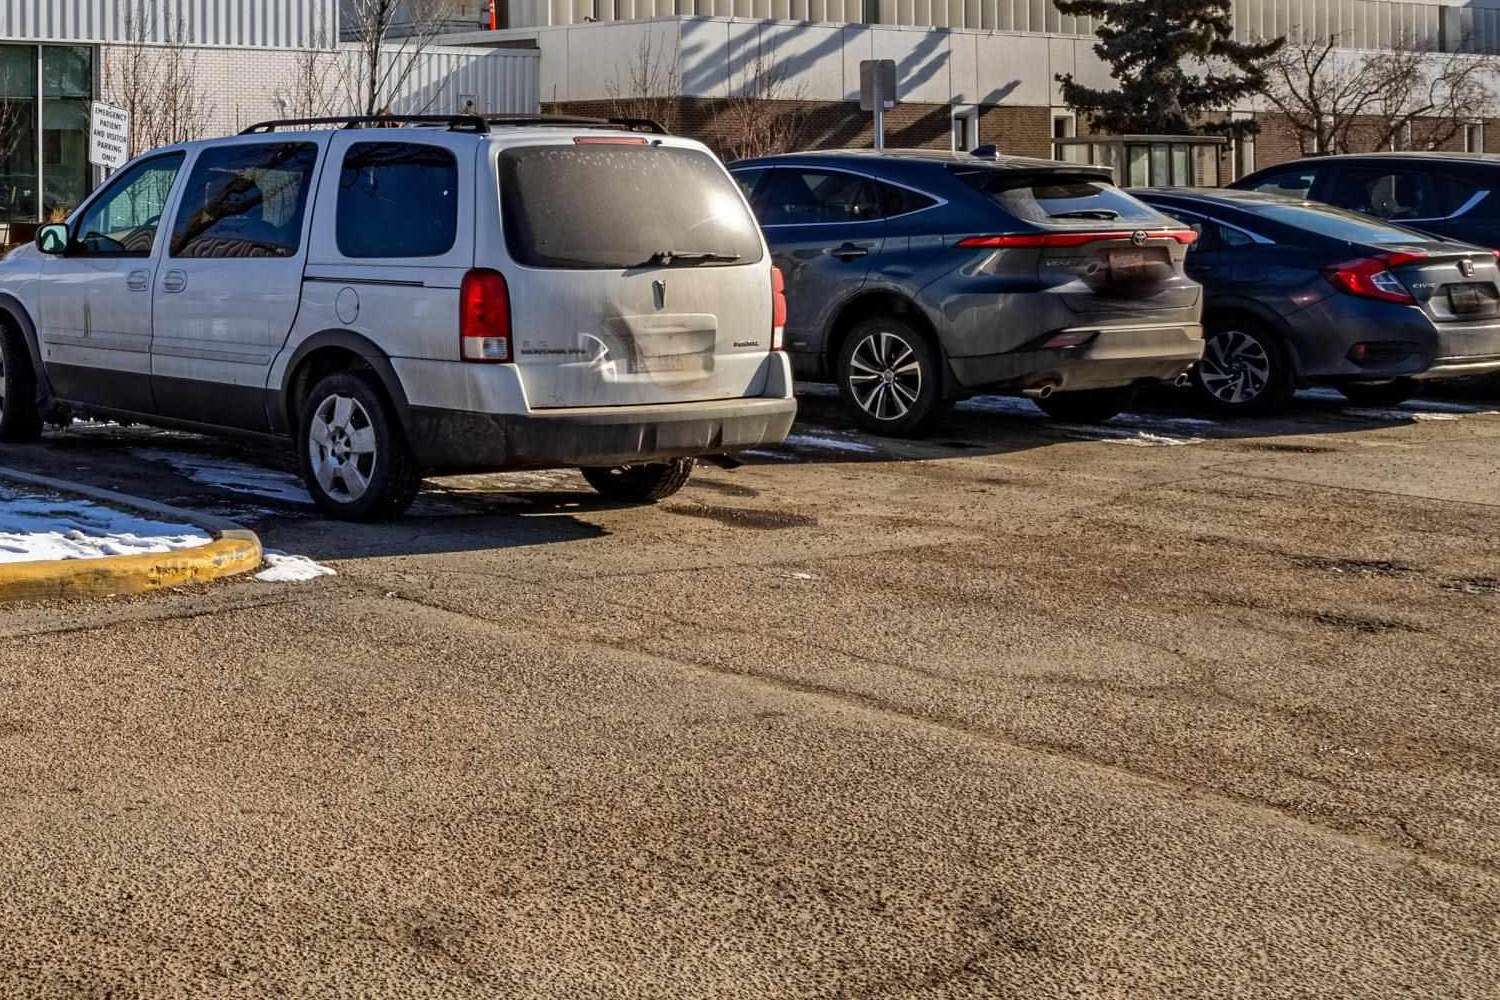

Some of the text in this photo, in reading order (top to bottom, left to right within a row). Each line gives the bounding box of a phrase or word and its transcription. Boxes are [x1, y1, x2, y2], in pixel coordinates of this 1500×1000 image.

[94, 106, 127, 122] EMERGENCY
[100, 119, 122, 131] PATIENT
[93, 128, 126, 143] AND VISITOR
[97, 140, 122, 153] PARKING
[101, 153, 116, 162] ONLY
